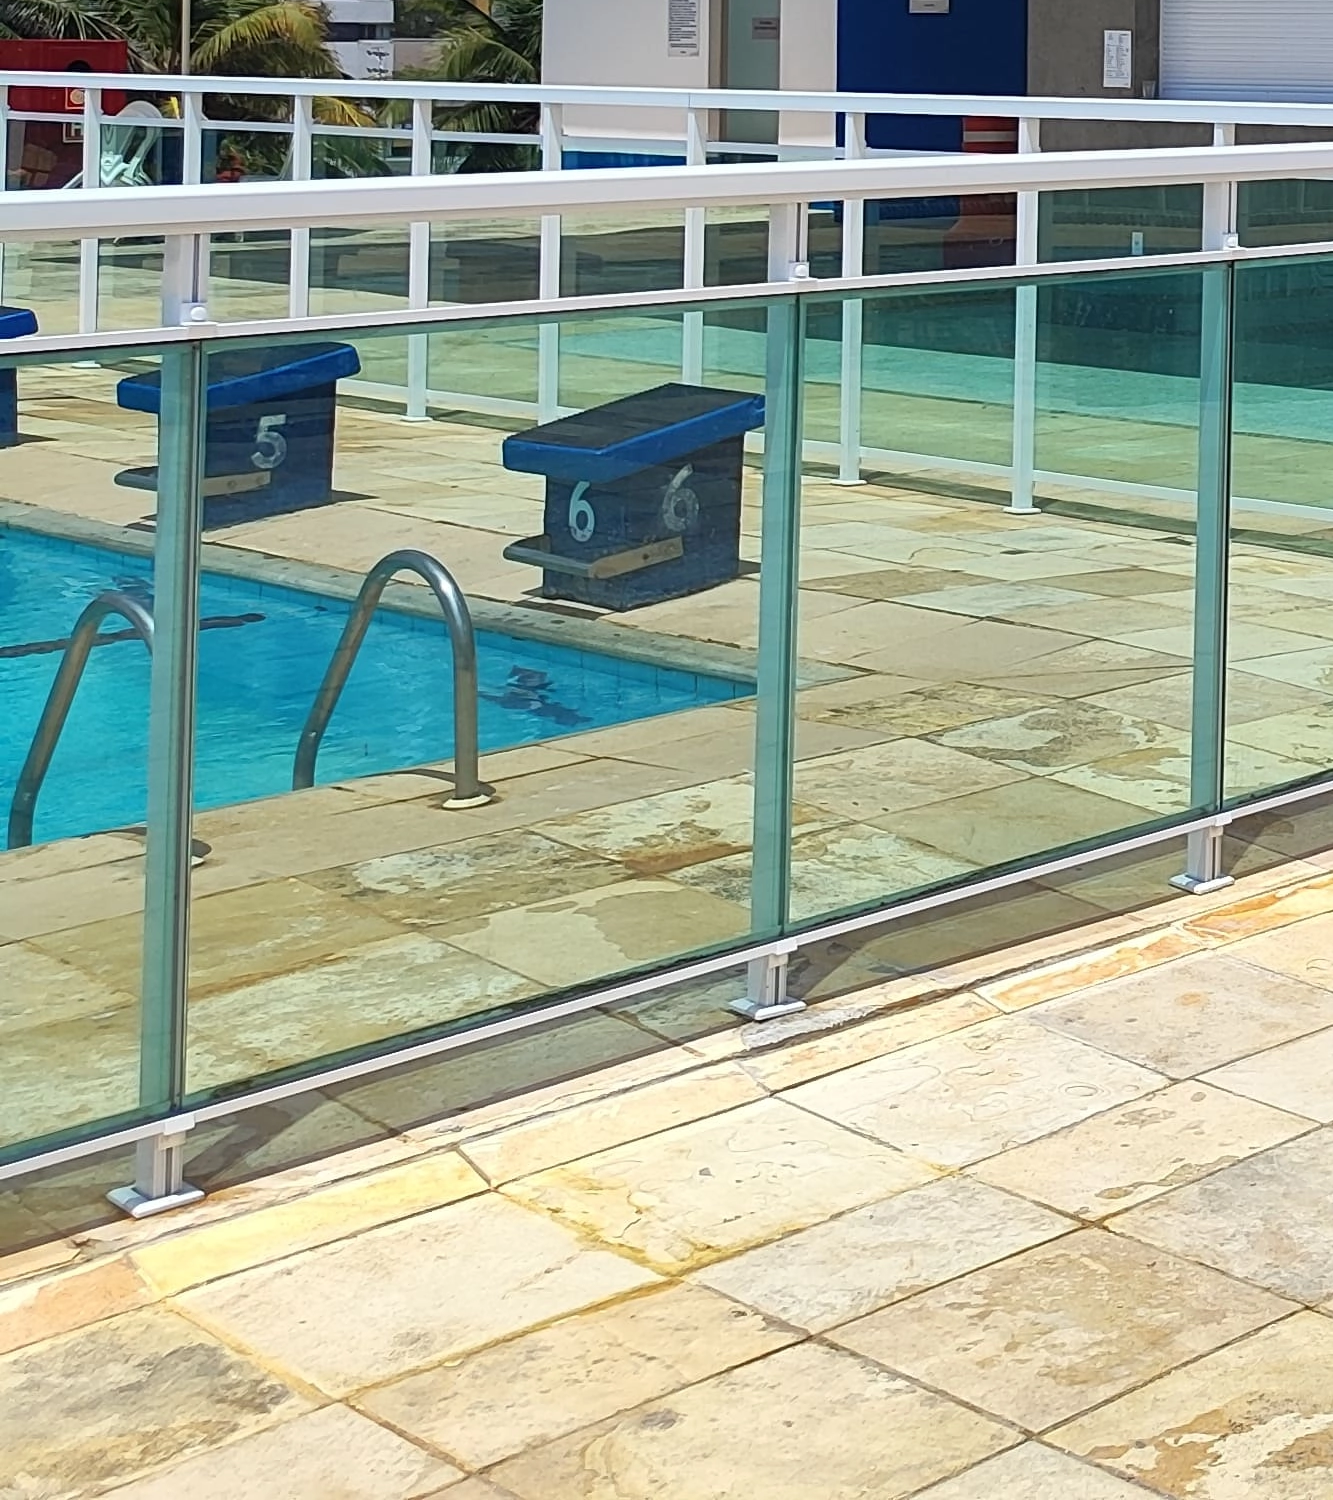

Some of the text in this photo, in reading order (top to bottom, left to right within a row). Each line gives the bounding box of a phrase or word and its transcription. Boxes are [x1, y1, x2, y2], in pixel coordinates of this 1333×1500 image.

[250, 414, 288, 469] 5
[567, 480, 596, 543] 6
[661, 462, 700, 533] 6
